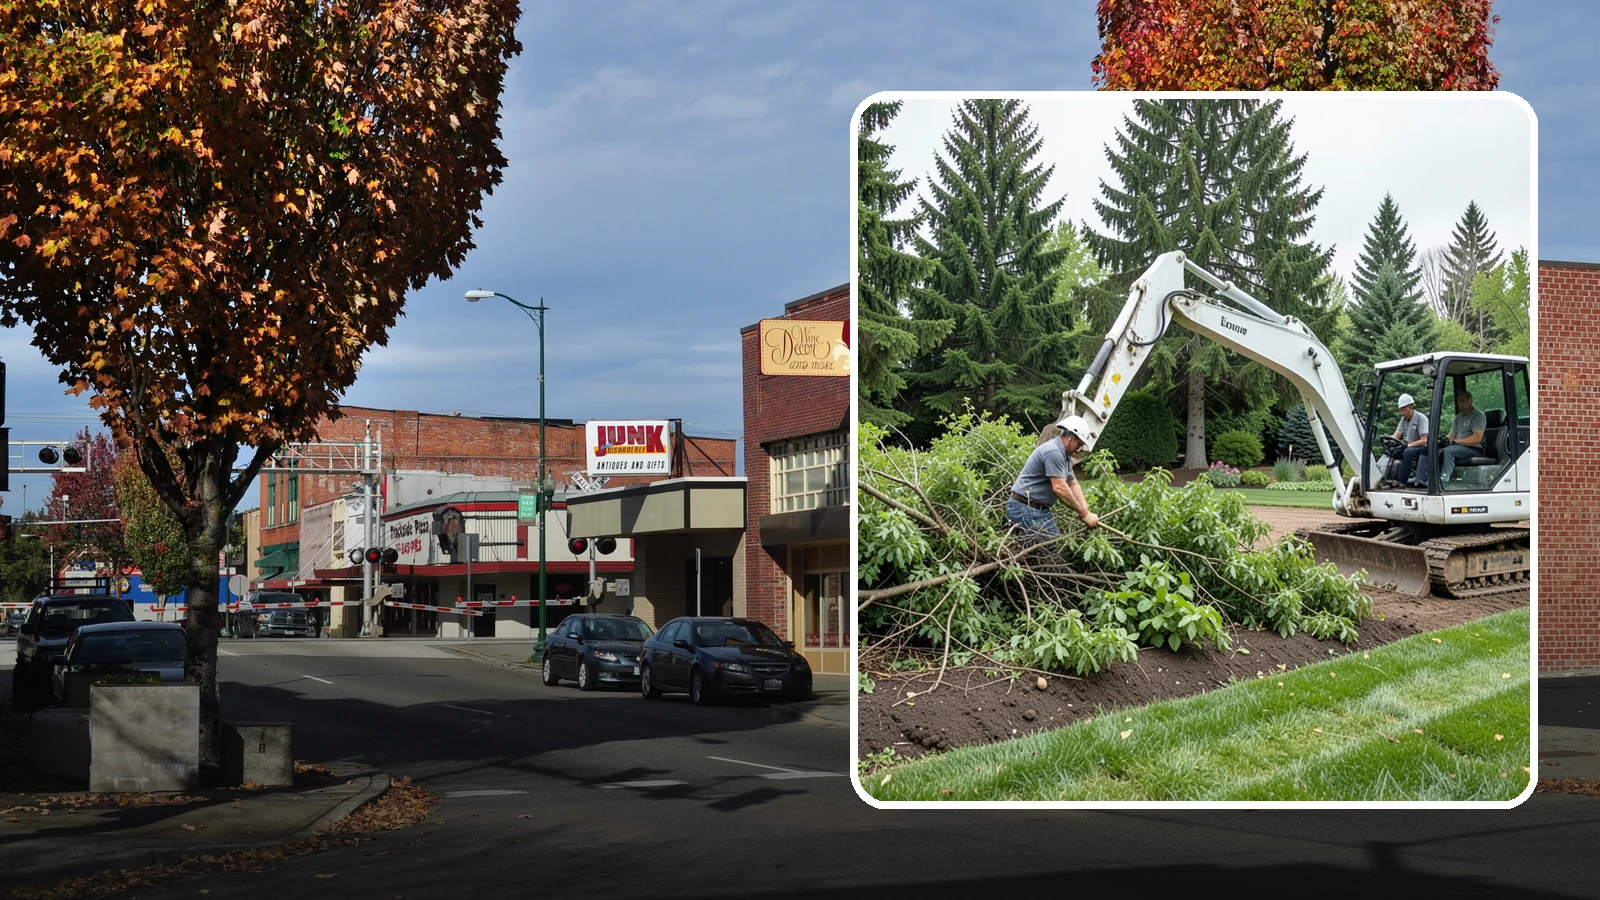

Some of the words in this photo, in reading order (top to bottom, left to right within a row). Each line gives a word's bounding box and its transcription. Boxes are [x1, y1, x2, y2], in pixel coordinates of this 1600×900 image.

[595, 425, 666, 457] JUNK
[607, 446, 646, 454] DISORDERLY
[597, 461, 628, 470] ANTIQUES
[631, 461, 644, 470] AND
[647, 460, 665, 470] GIFTS
[414, 519, 429, 535] Pizza
